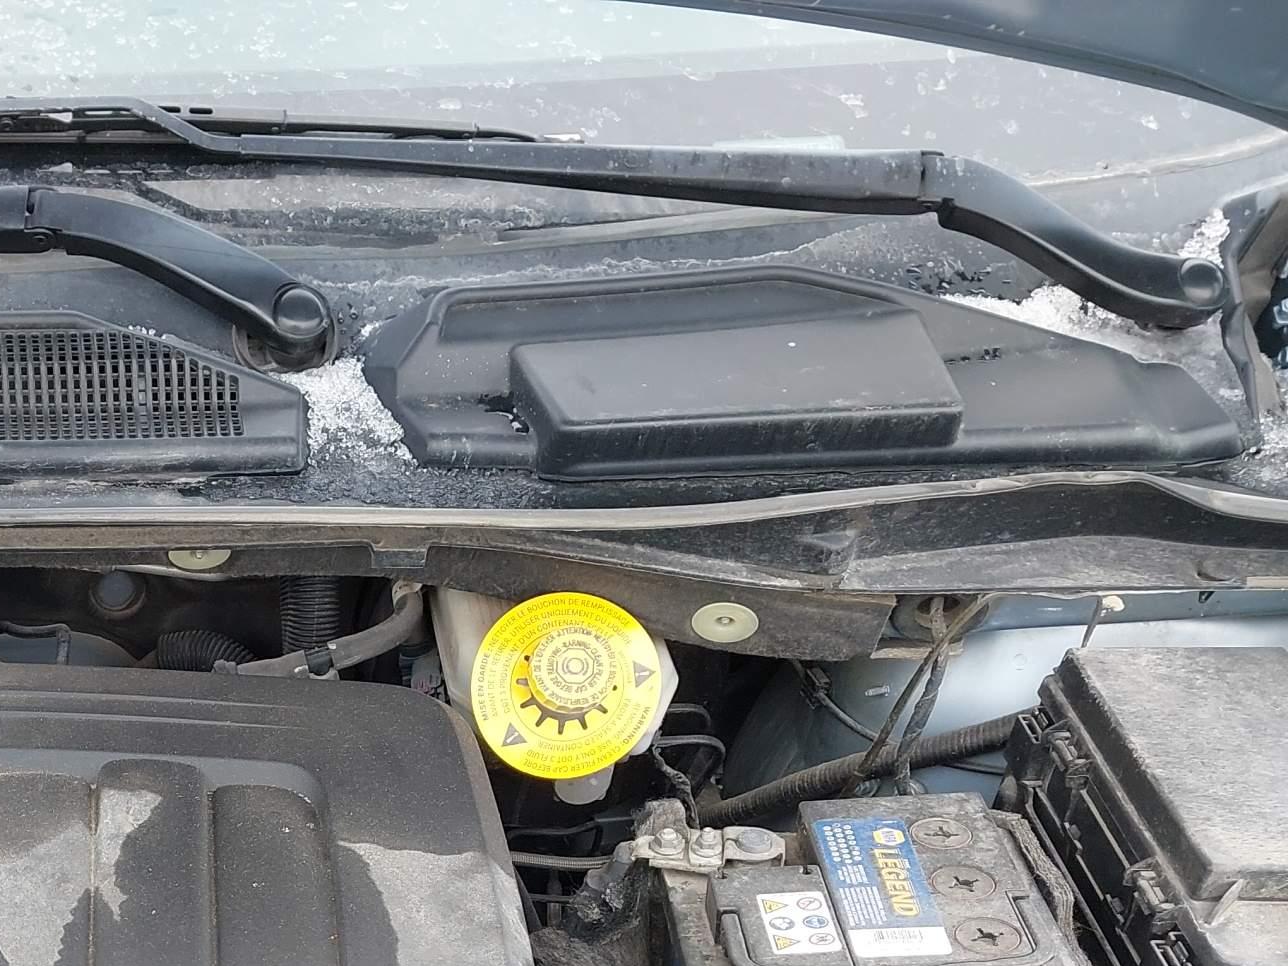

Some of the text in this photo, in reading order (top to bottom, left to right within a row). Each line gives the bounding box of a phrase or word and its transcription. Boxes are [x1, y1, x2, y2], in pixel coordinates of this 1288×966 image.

[515, 610, 525, 619] LE
[526, 598, 565, 614] BOUCHON
[580, 599, 629, 627] REMPLISSAGE
[487, 616, 516, 647] NETTOYER
[508, 614, 539, 638] UTILISER
[539, 607, 593, 619] UNIQUEMENT
[594, 613, 607, 624] DU
[498, 642, 520, 688] PROVENANT
[517, 628, 536, 644] D'UN
[535, 619, 583, 632] CONTENANT
[477, 685, 484, 696] EN
[478, 699, 491, 721] MISE
[523, 706, 650, 773] WARNING: CLEAN FILLER CAP BEFORE
[537, 737, 583, 752] CONTAINER
[526, 748, 547, 762] FLUID
[556, 755, 572, 763] DOT
[574, 748, 596, 760] ONLY
[872, 847, 921, 918] LEGEND
